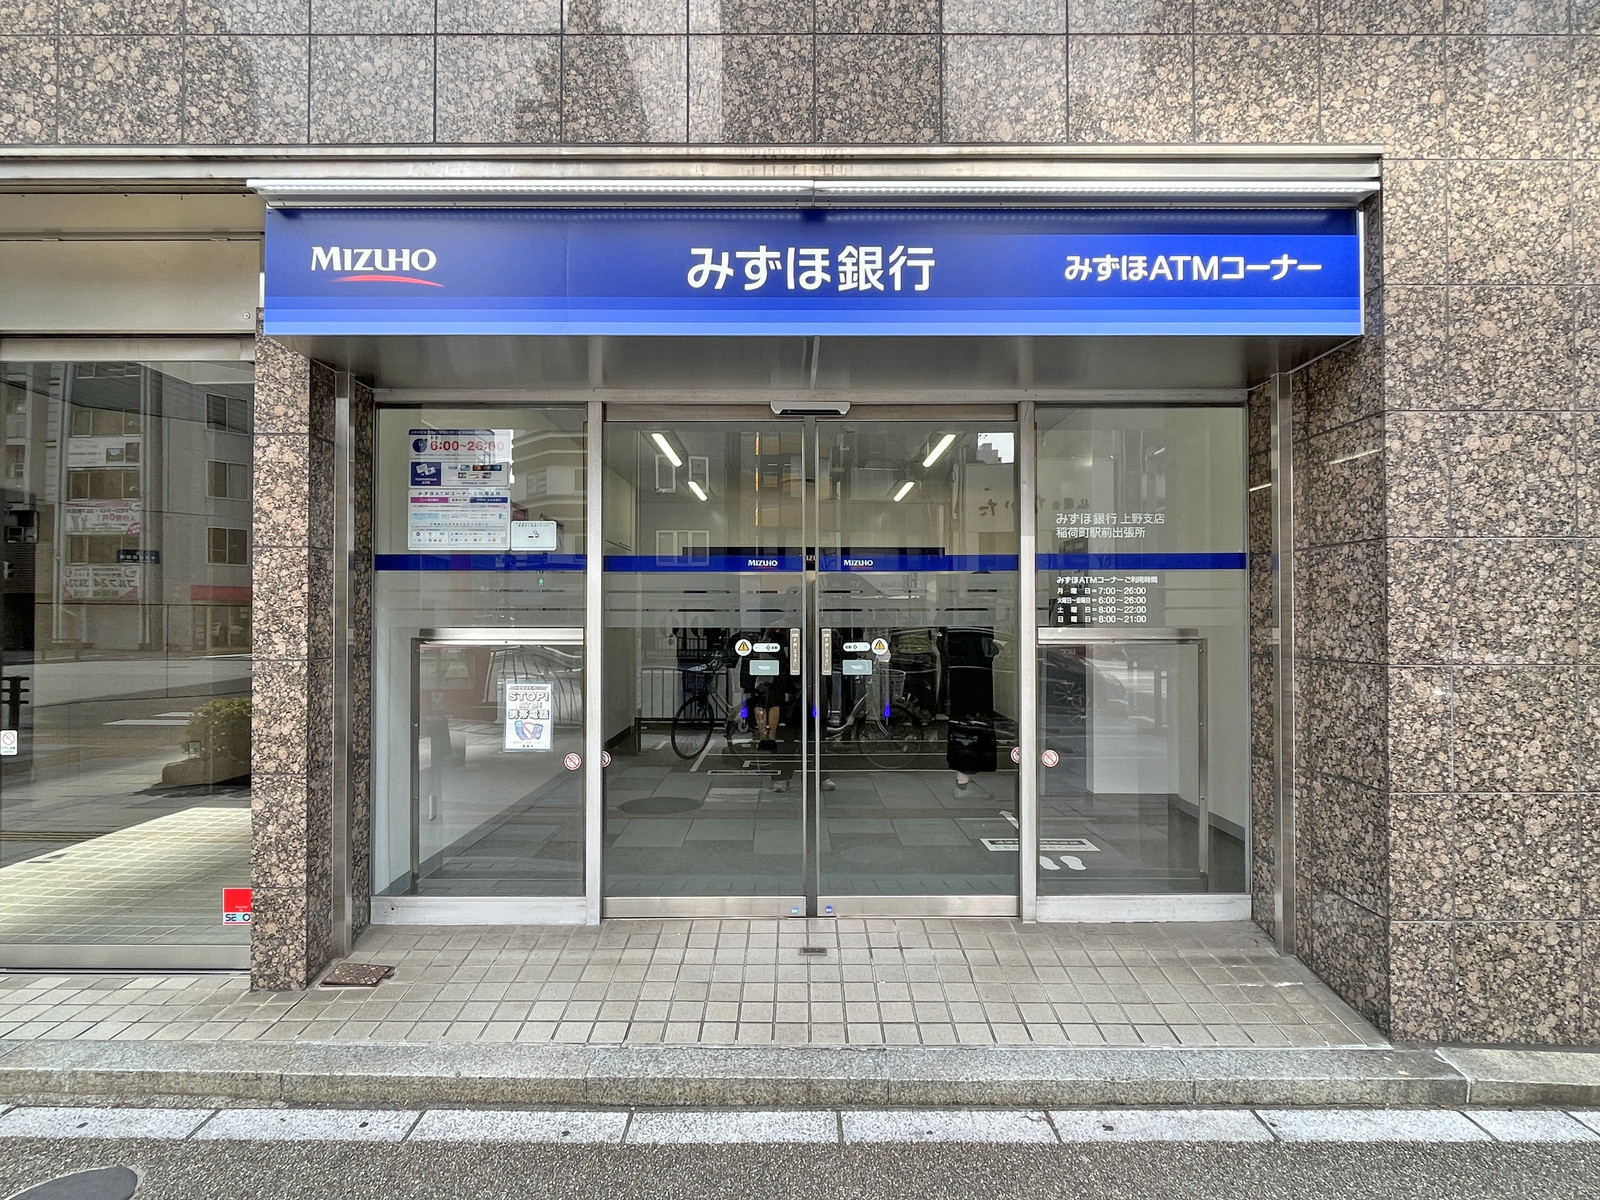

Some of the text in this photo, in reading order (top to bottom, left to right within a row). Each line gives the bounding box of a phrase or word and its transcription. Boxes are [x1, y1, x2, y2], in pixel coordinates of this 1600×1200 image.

[310, 246, 437, 272] MIZUHO
[687, 244, 936, 293] みずほ銀行
[1064, 252, 1322, 282] みずほATMコーナー
[1055, 512, 1165, 525] みずほ銀行 上野支店
[1055, 526, 1147, 539] 稲荷町駅前出張所
[747, 559, 778, 567] MIZUHO
[843, 559, 874, 567] MIZUHO
[508, 691, 550, 702] STOP!
